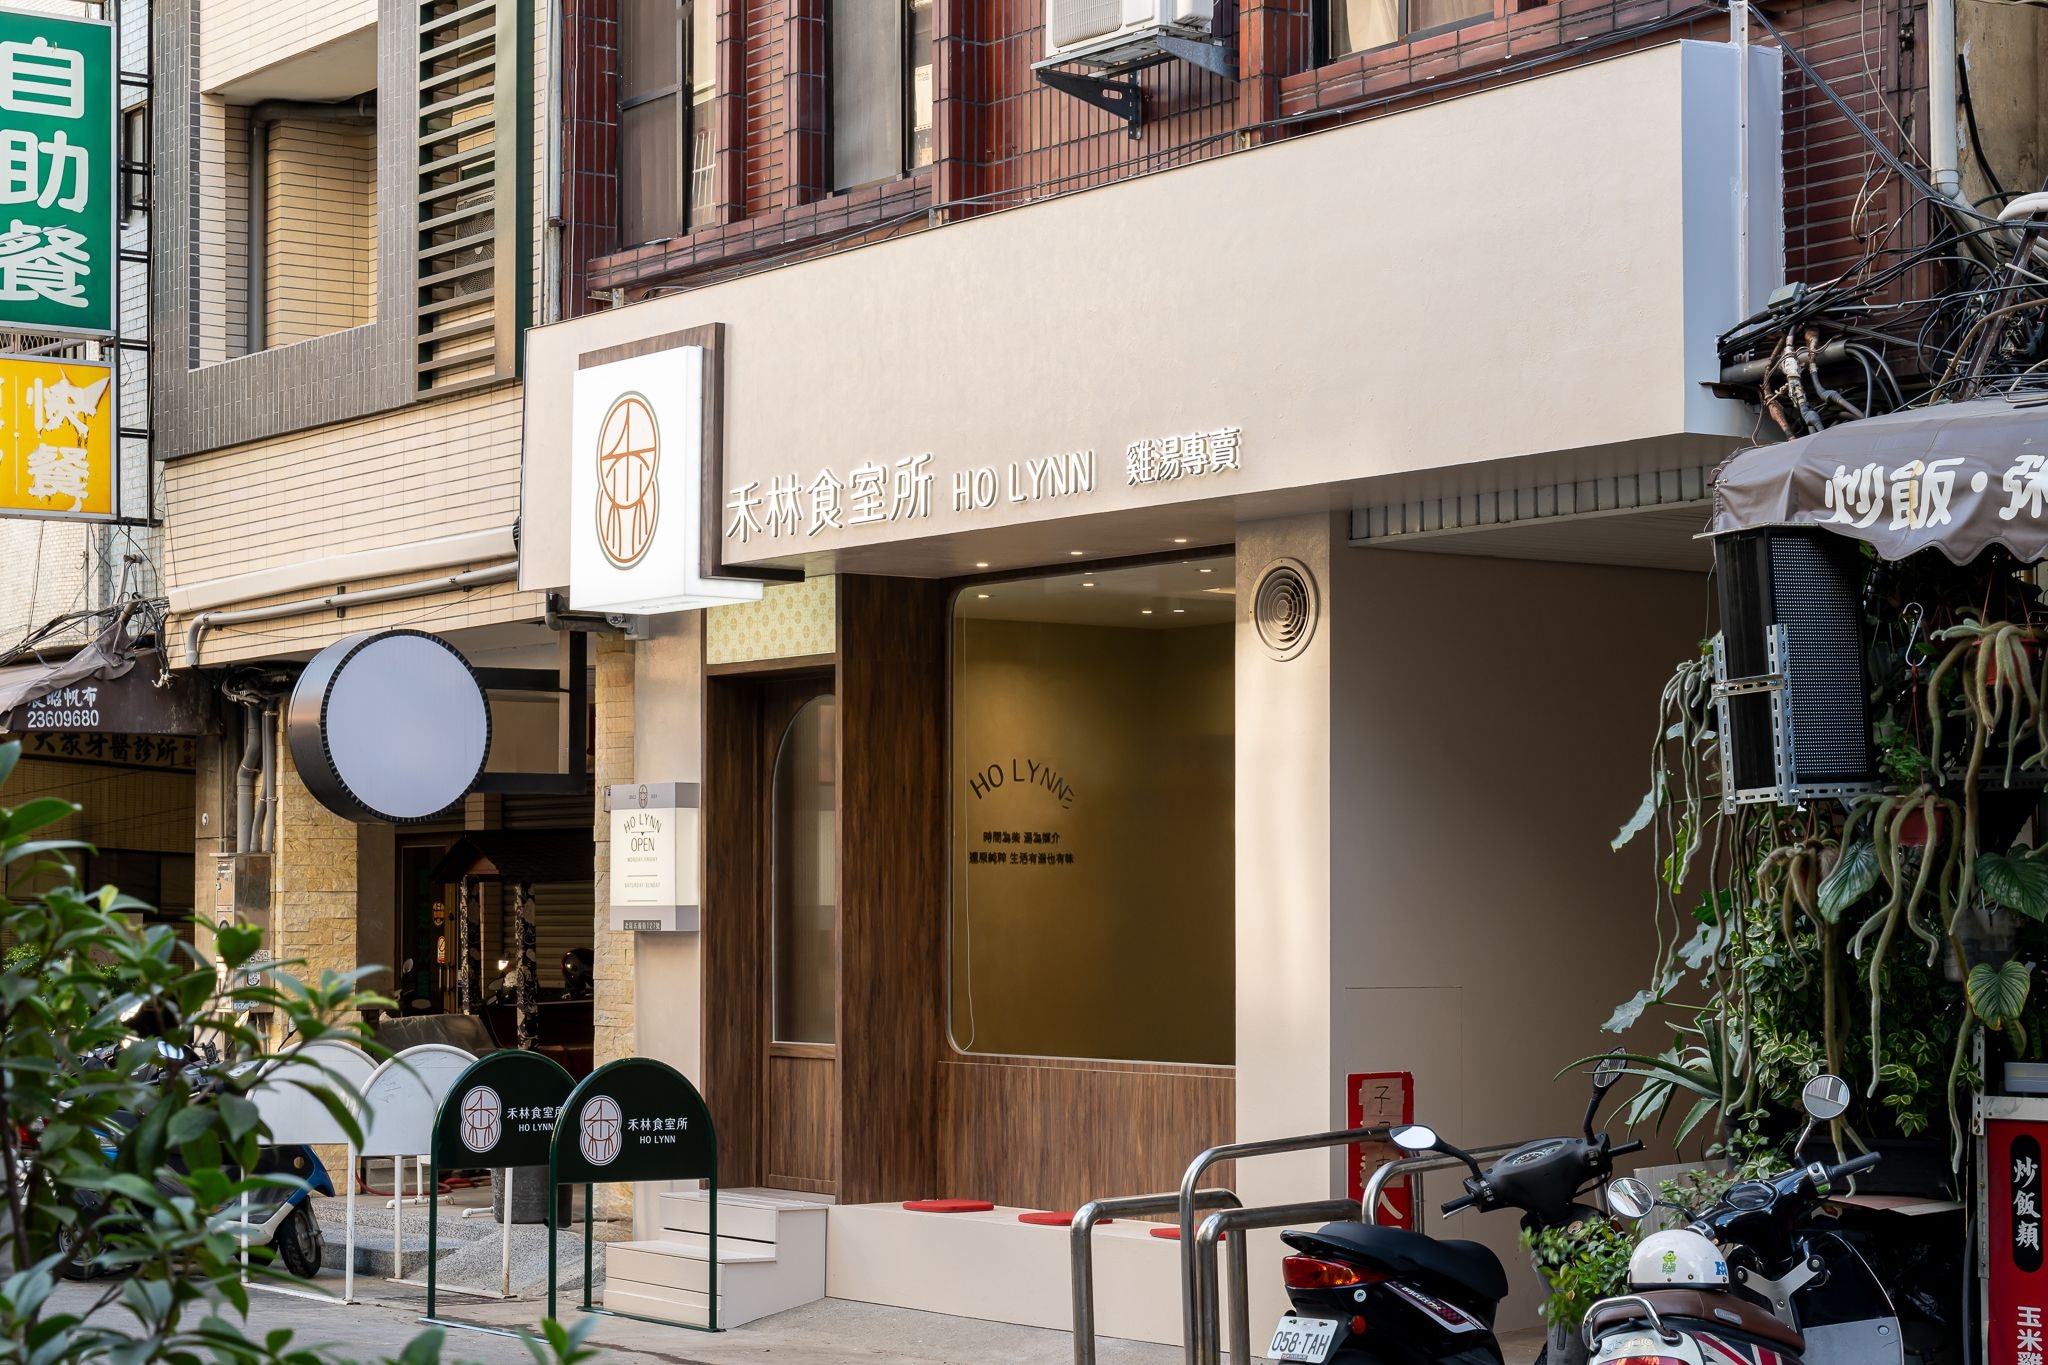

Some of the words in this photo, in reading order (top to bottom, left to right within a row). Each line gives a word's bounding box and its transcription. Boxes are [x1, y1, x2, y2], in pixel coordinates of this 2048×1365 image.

[0, 36, 91, 308] 自助餐
[1125, 426, 1242, 488] 雞湯專賣
[951, 466, 999, 513] HO
[1007, 449, 1097, 504] LYNN
[726, 451, 935, 544] 禾林食室所
[27, 709, 99, 728] 23609680
[969, 763, 1004, 800] HO
[623, 816, 636, 834] HO
[639, 813, 662, 833] LYNN
[630, 837, 655, 852] OPEN
[518, 1123, 530, 1132] HO
[532, 1122, 554, 1132] LYNN
[627, 1117, 688, 1131] 禾林食室所
[639, 1135, 651, 1144] HO
[654, 1135, 676, 1144] LYNN
[2013, 1156, 2041, 1251] 炒飯類
